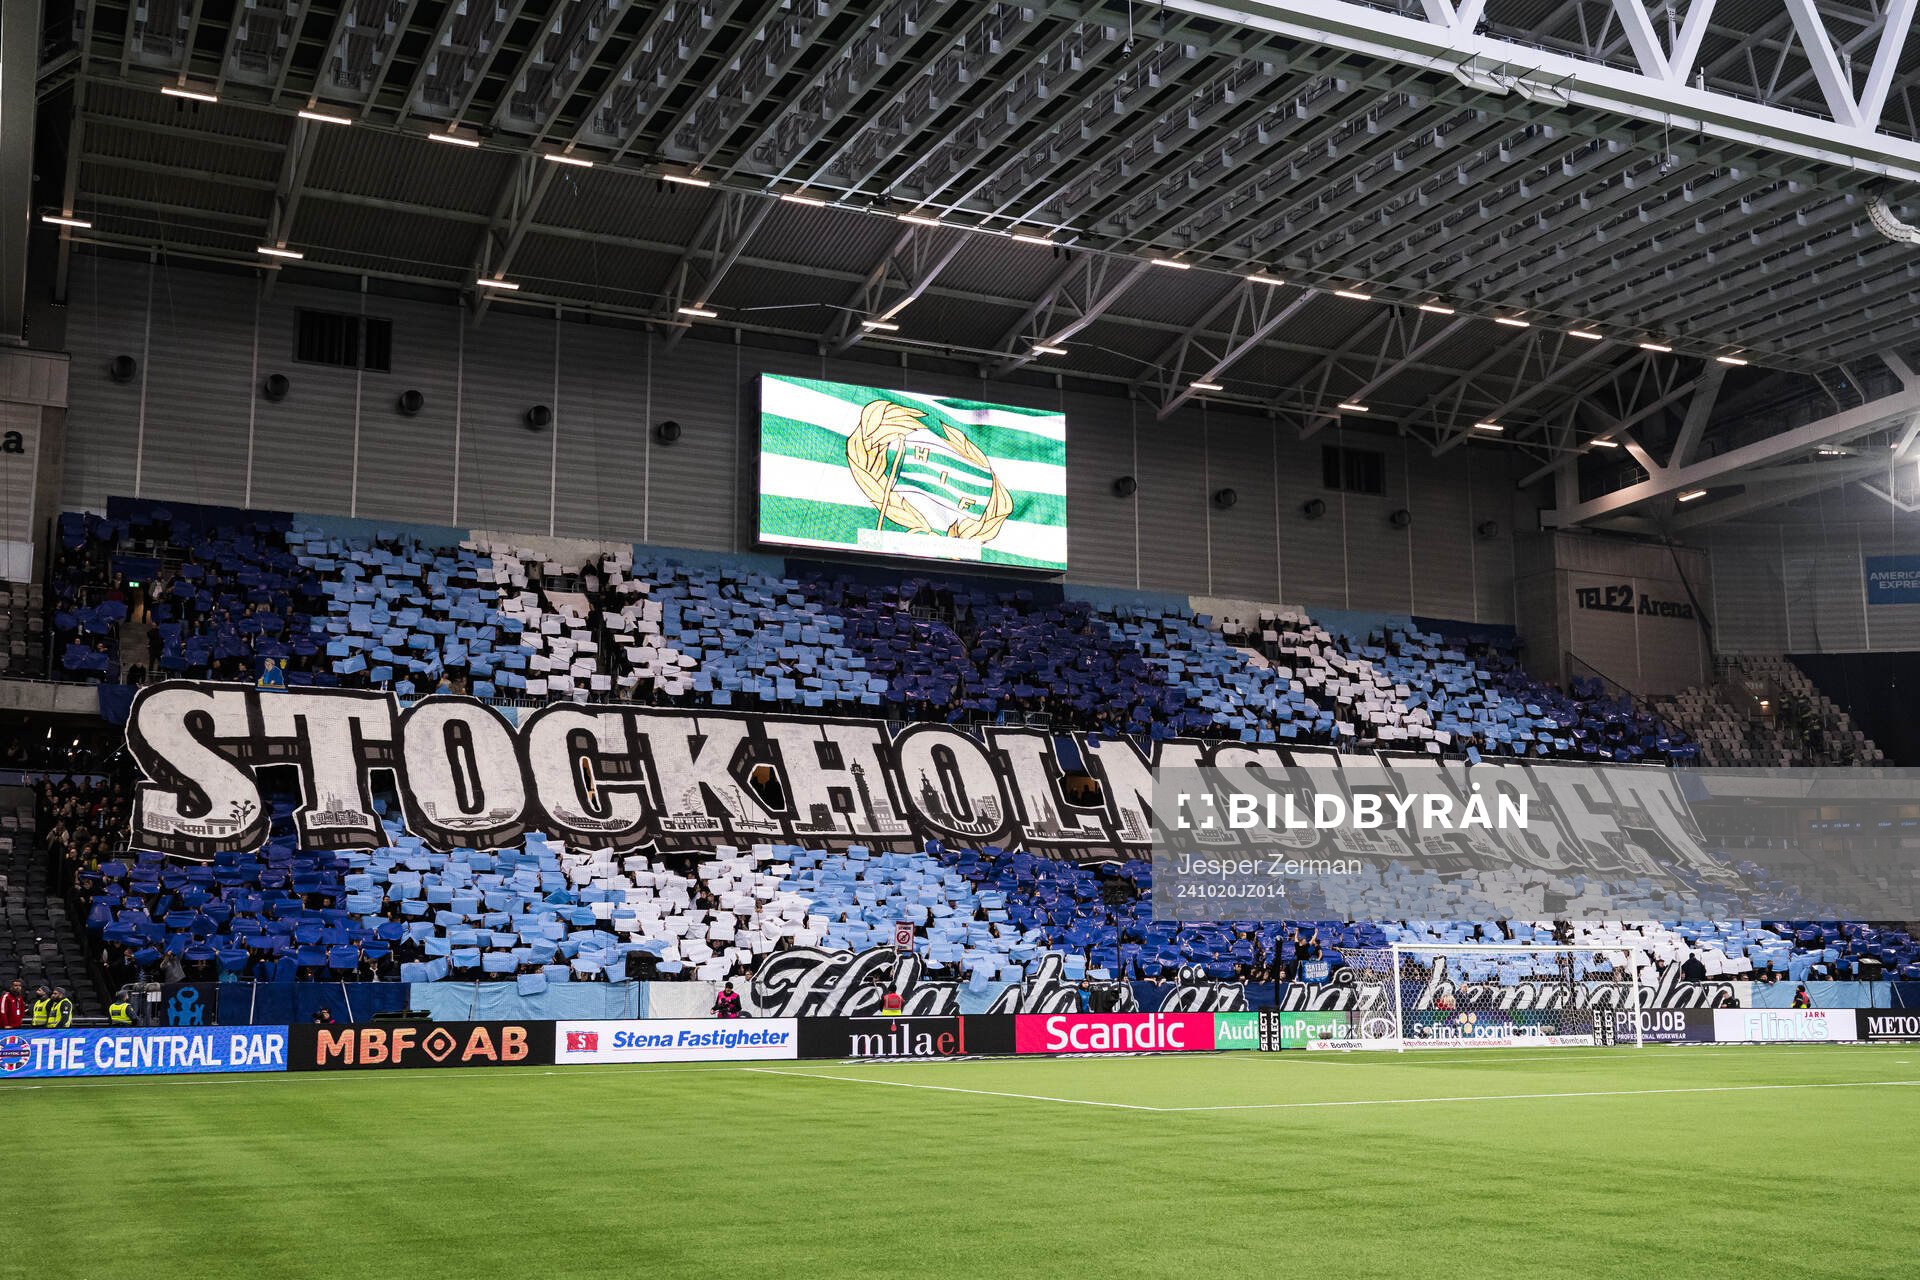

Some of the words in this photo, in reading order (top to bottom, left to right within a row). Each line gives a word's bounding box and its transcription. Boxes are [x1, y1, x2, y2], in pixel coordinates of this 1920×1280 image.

[1576, 585, 1635, 613] TELE2
[1639, 594, 1694, 620] Arena
[612, 1030, 674, 1048] Stena
[677, 1029, 790, 1049] Fastigheter
[848, 1015, 969, 1057] milael
[1045, 1013, 1185, 1050] Scandic
[1260, 1011, 1269, 1052] SELECT
[1270, 1011, 1280, 1052] SELECT
[1744, 1012, 1829, 1041] Flinks
[1867, 1015, 1920, 1035] METO
[31, 1037, 86, 1070] THE
[94, 1036, 222, 1068] CENTRAL
[229, 1034, 284, 1065] BAR
[316, 1027, 417, 1065] MBF
[461, 1026, 529, 1061] AB
